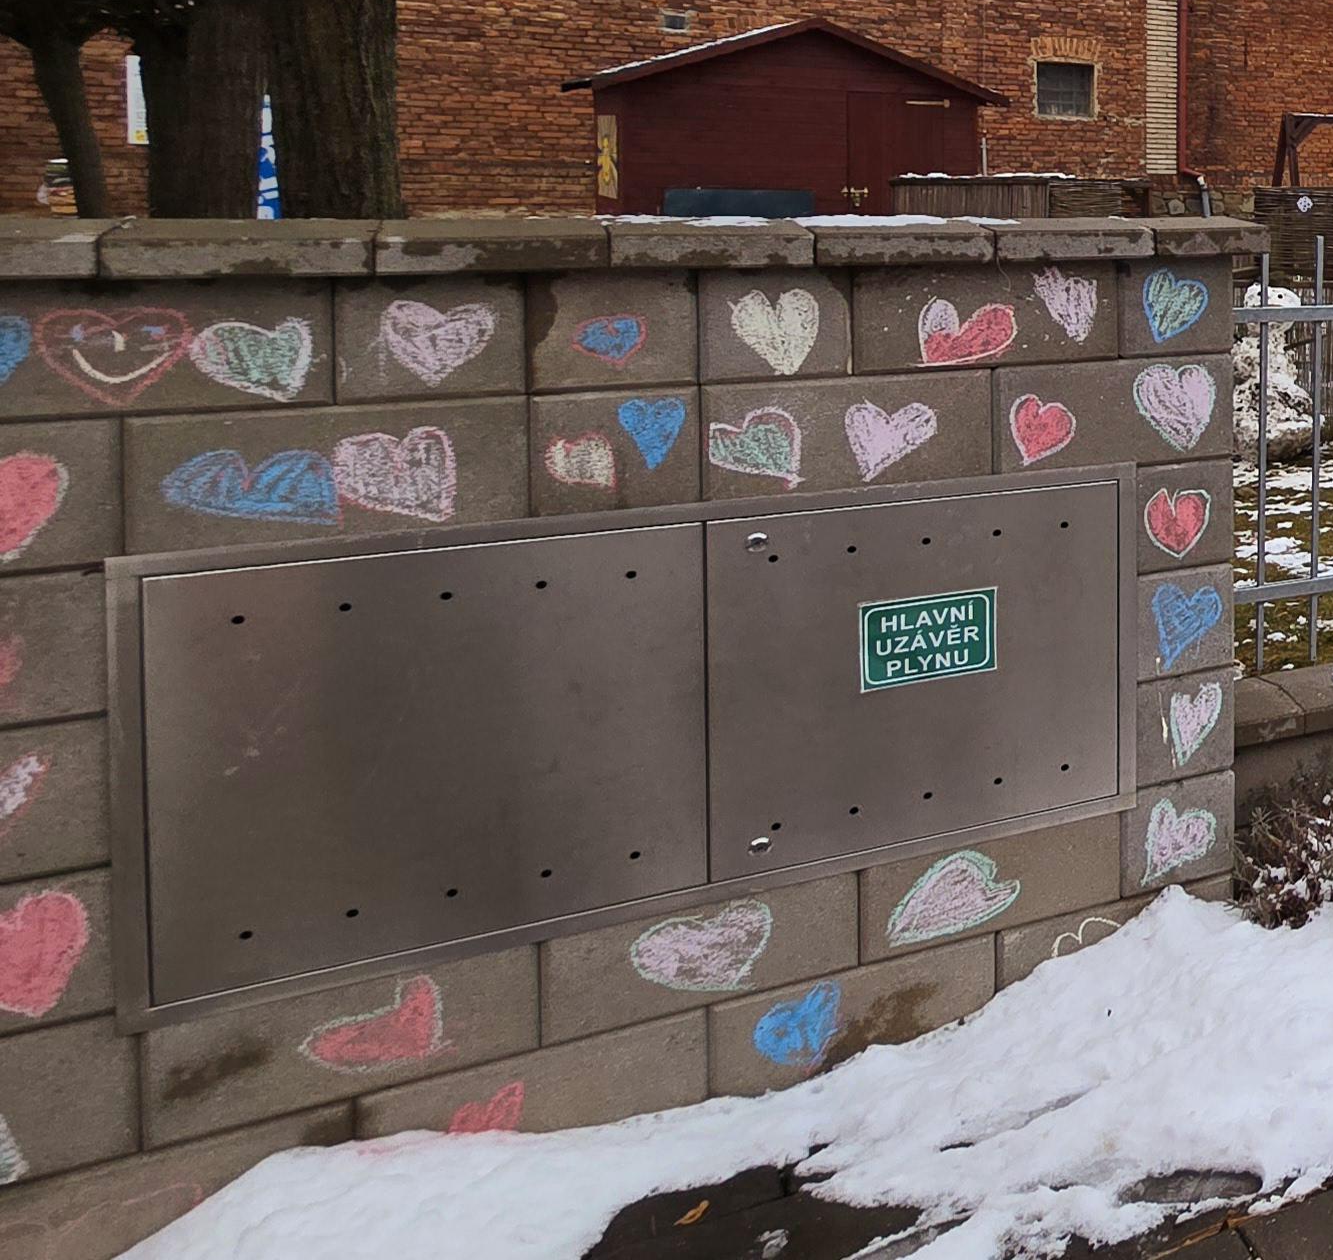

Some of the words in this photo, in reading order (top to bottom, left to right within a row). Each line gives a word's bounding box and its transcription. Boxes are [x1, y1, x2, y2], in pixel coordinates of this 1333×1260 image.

[881, 600, 974, 633] HLAVNÍ
[876, 624, 980, 656] UZÁVĚR
[886, 648, 969, 677] PLYNU
